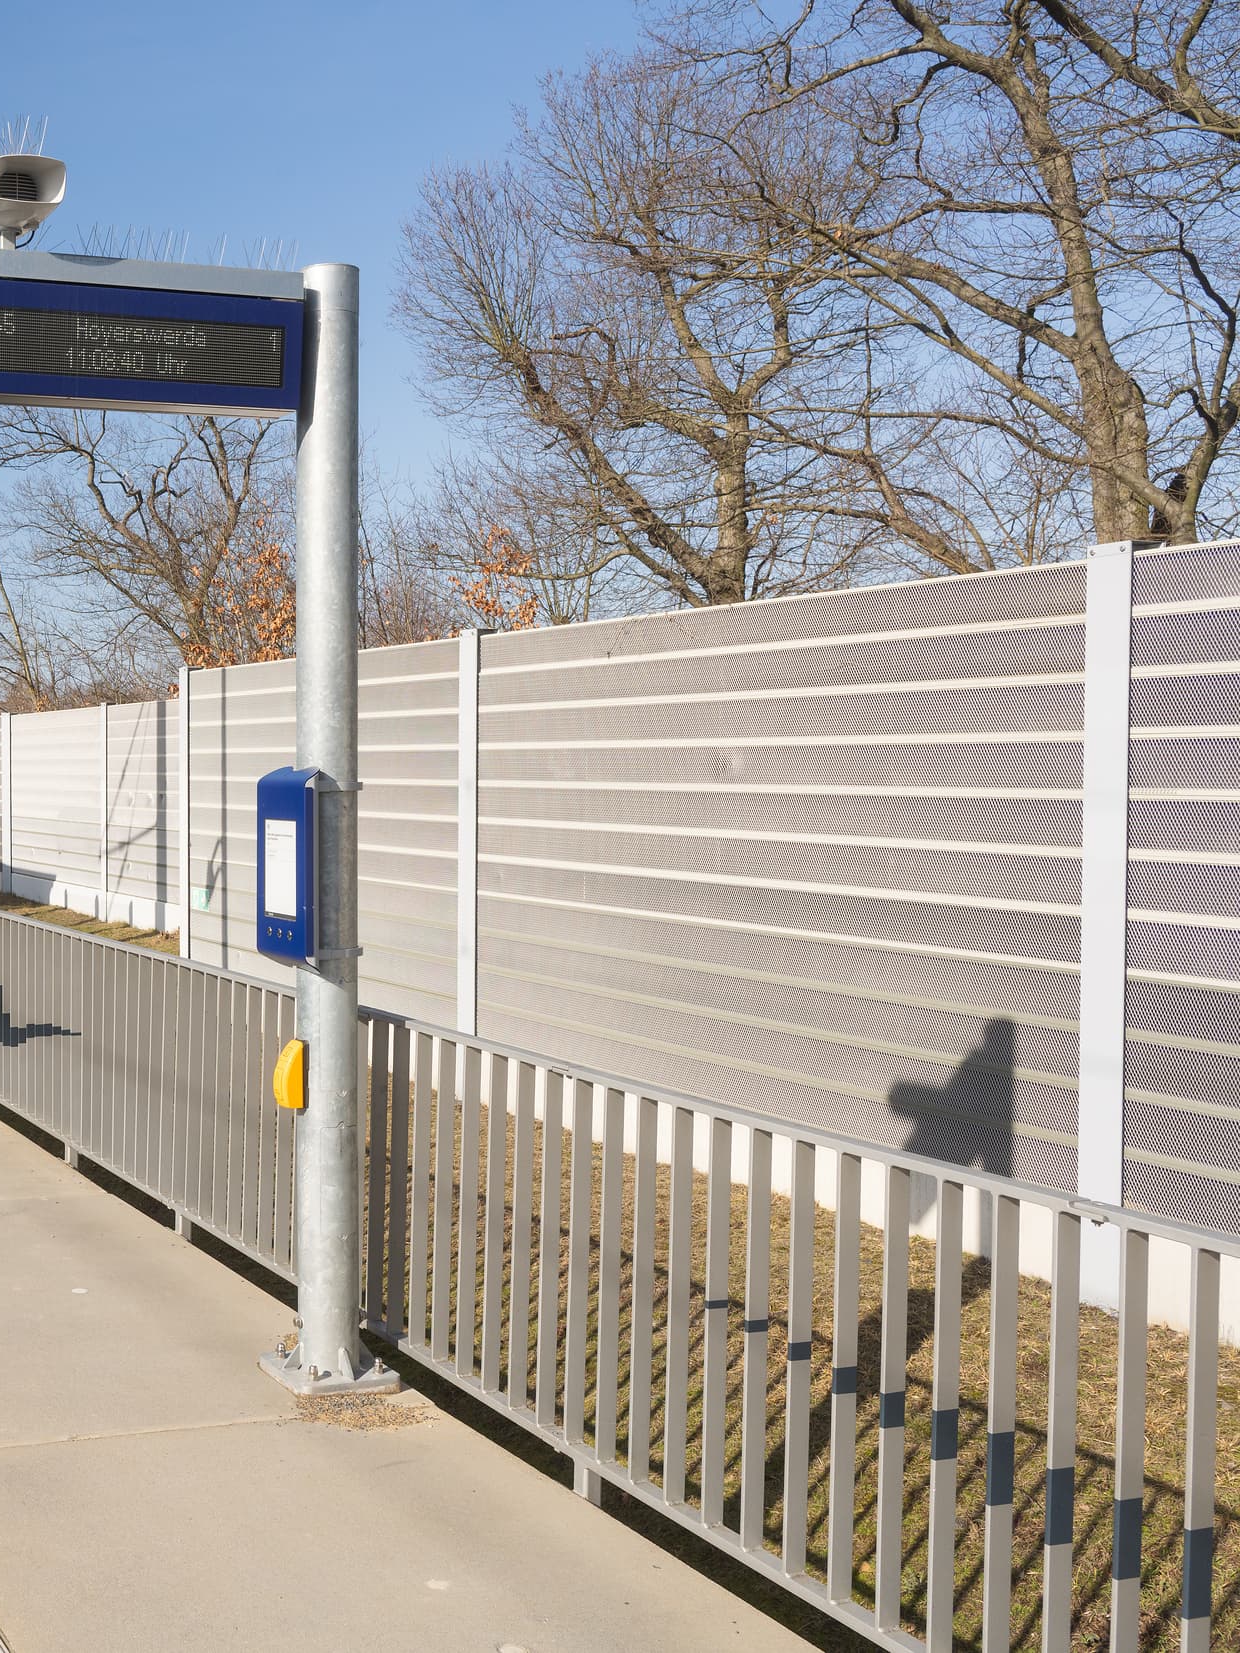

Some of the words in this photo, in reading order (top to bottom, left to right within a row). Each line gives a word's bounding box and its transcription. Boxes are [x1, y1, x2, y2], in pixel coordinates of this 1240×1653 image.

[77, 317, 206, 347] Hoyerswerda
[270, 331, 277, 352] 1
[65, 347, 144, 372] 11:08:40
[157, 353, 188, 375] Uhr
